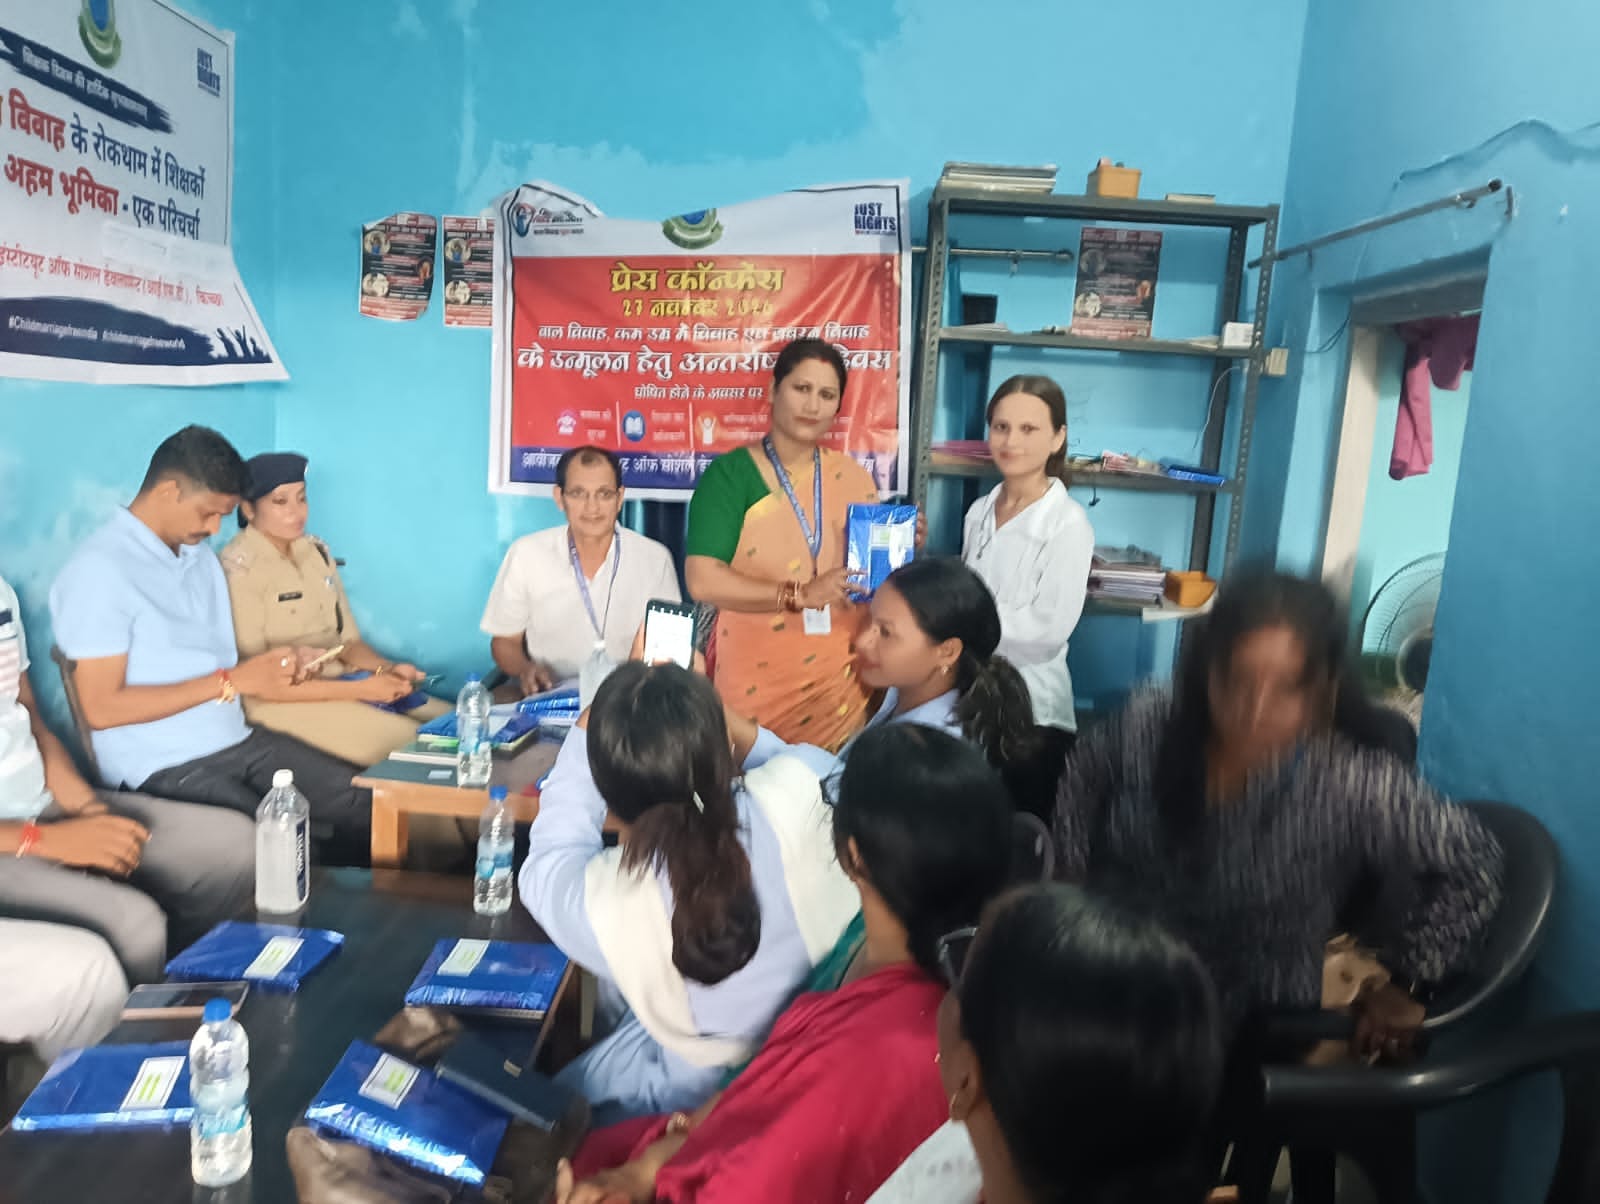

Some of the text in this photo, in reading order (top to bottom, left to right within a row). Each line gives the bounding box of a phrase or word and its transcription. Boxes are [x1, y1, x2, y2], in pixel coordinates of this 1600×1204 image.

[8, 87, 66, 152] विवाह
[70, 112, 89, 154] के
[92, 122, 148, 179] रोकथाम
[151, 144, 162, 184] में
[164, 151, 206, 200] शिक्षकों
[4, 154, 54, 197] अहम
[59, 166, 120, 216] भूमिका
[132, 196, 154, 228] एक
[158, 197, 200, 241] परिचर्चा
[855, 202, 882, 216] JUST
[855, 216, 896, 230] RIGHTS
[610, 262, 659, 292] प्रेस
[517, 341, 545, 369] के
[549, 349, 631, 379] उन्मूलन
[636, 344, 673, 380] हेतु
